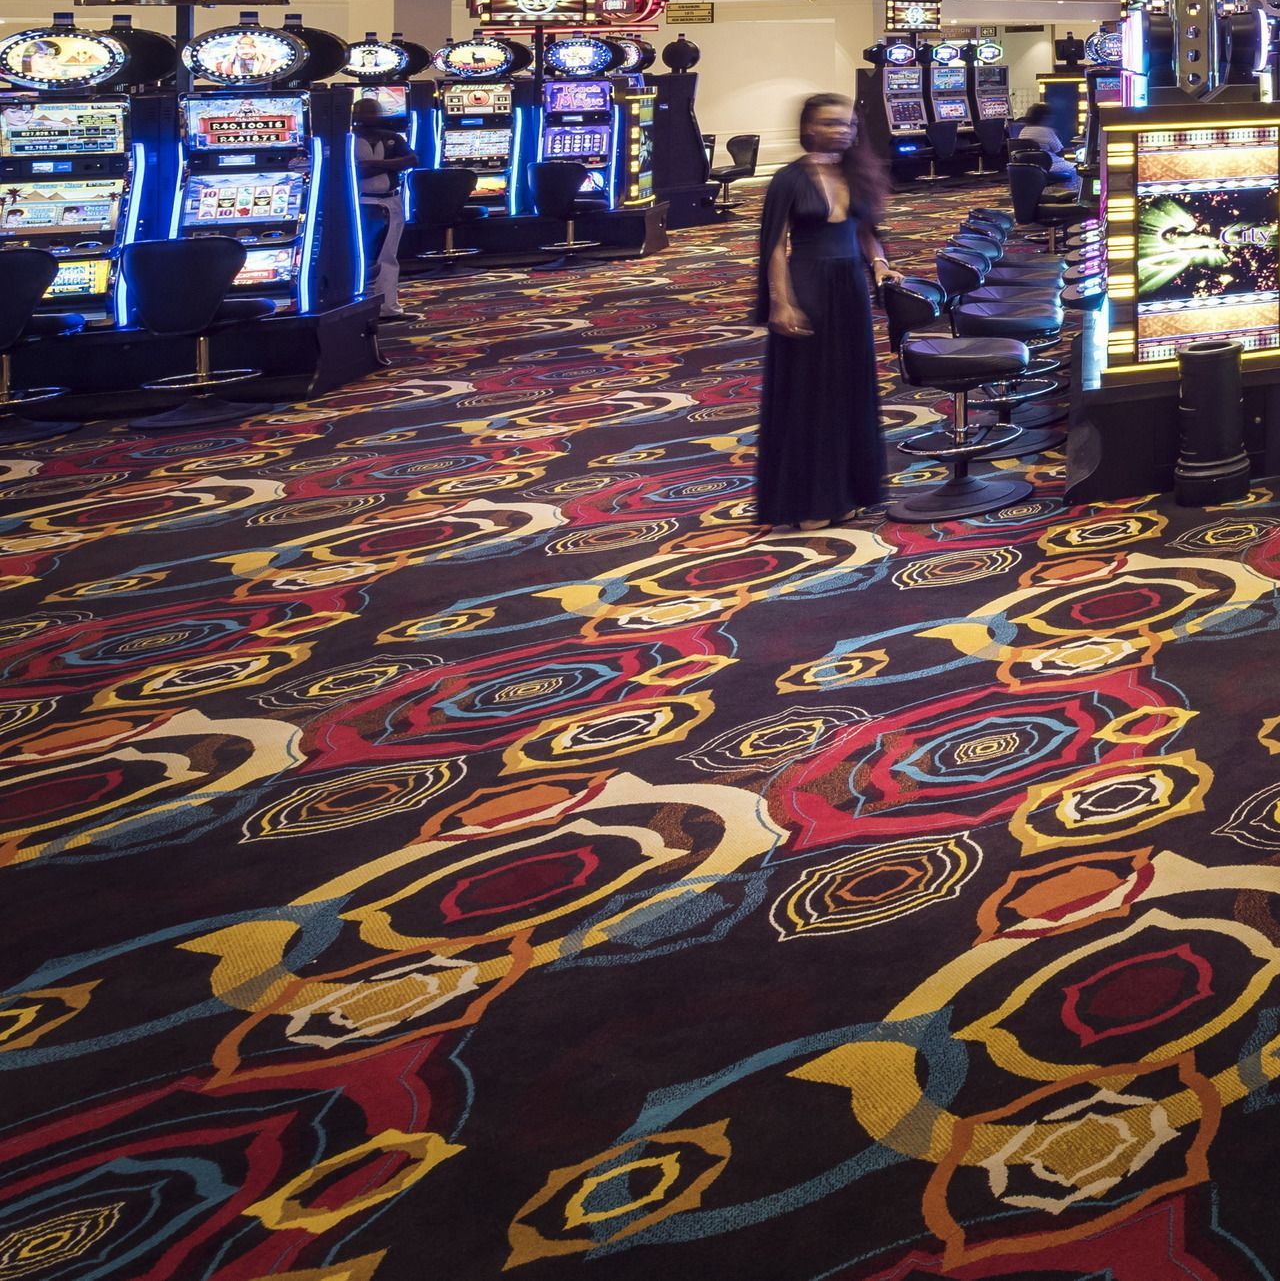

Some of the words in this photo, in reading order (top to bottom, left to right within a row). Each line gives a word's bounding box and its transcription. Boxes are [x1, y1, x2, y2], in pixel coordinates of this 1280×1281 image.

[212, 121, 283, 130] R40,100.16
[203, 190, 217, 198] 10
[218, 208, 232, 217] 10
[1219, 226, 1272, 247] City
